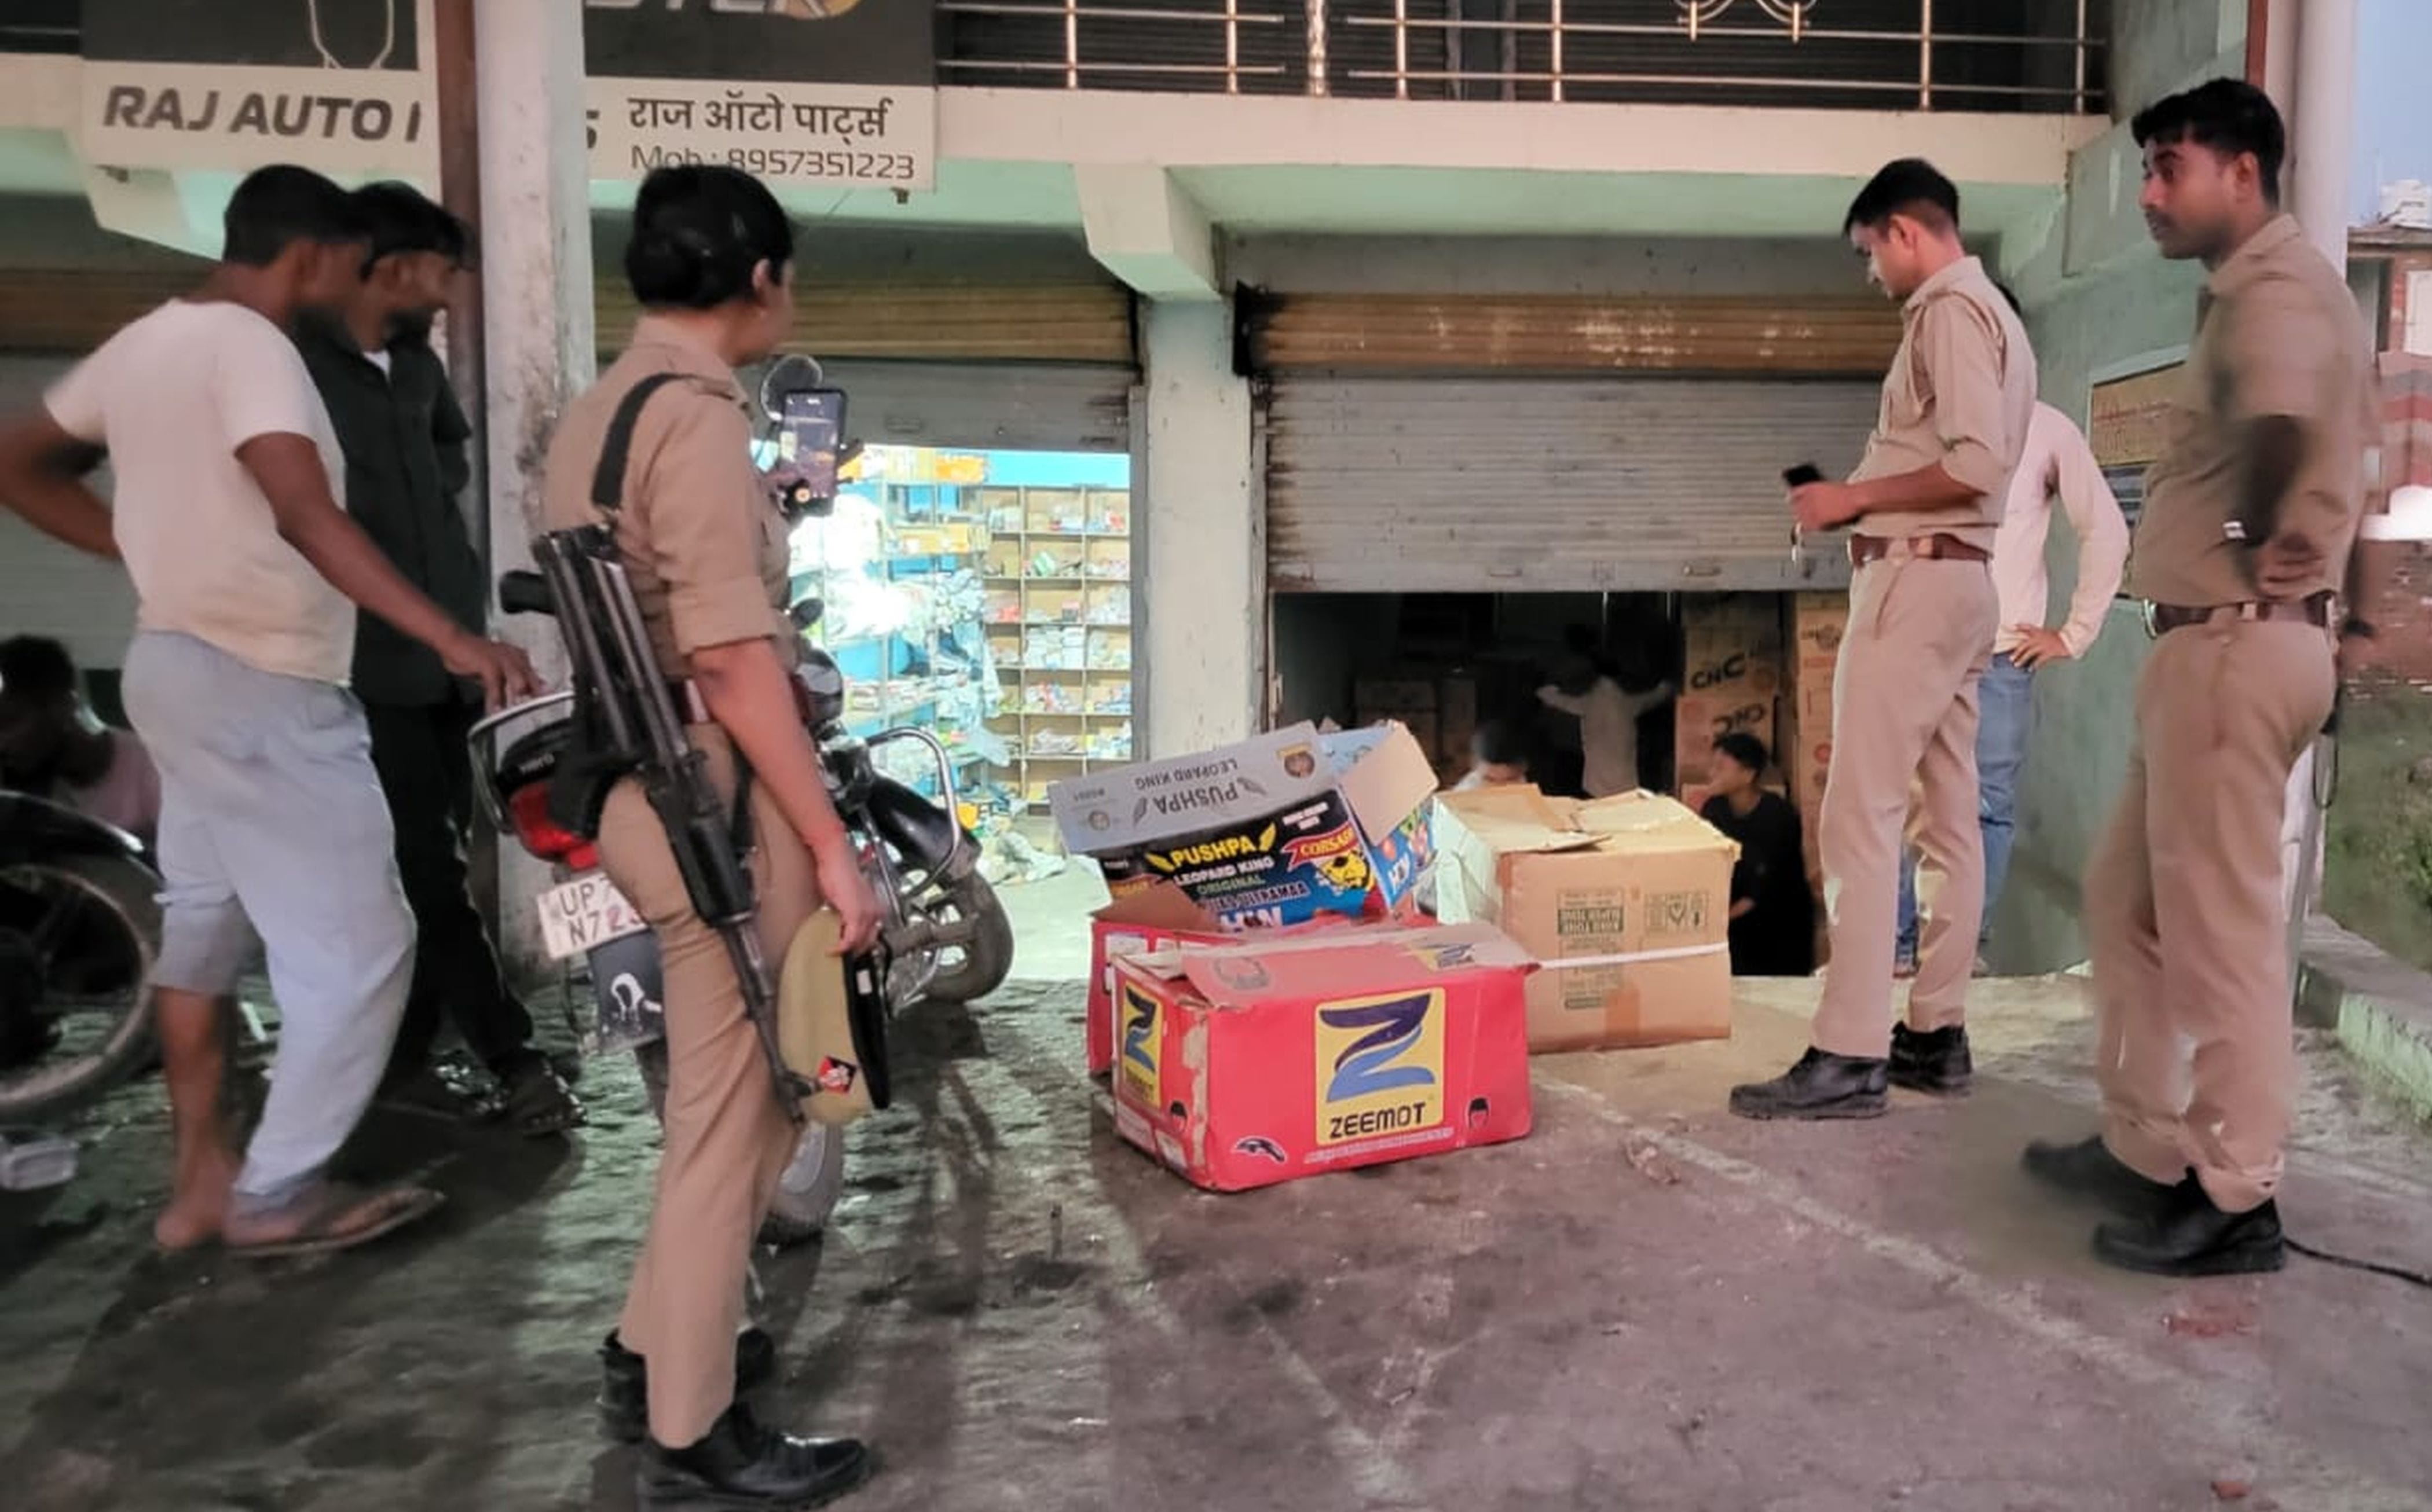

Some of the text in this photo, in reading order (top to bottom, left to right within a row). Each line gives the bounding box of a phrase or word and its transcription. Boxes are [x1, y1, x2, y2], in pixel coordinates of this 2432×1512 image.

[103, 86, 219, 131] RAJ
[229, 93, 393, 141] AUTO
[627, 97, 695, 129] राज
[704, 90, 785, 133] ऑटो
[728, 148, 914, 180] 8957351223
[1153, 781, 1239, 815] PUSHPA
[1169, 835, 1257, 868] PUSHPA
[1237, 855, 1275, 874] KING
[1329, 1102, 1426, 1139] ZEEMOT
